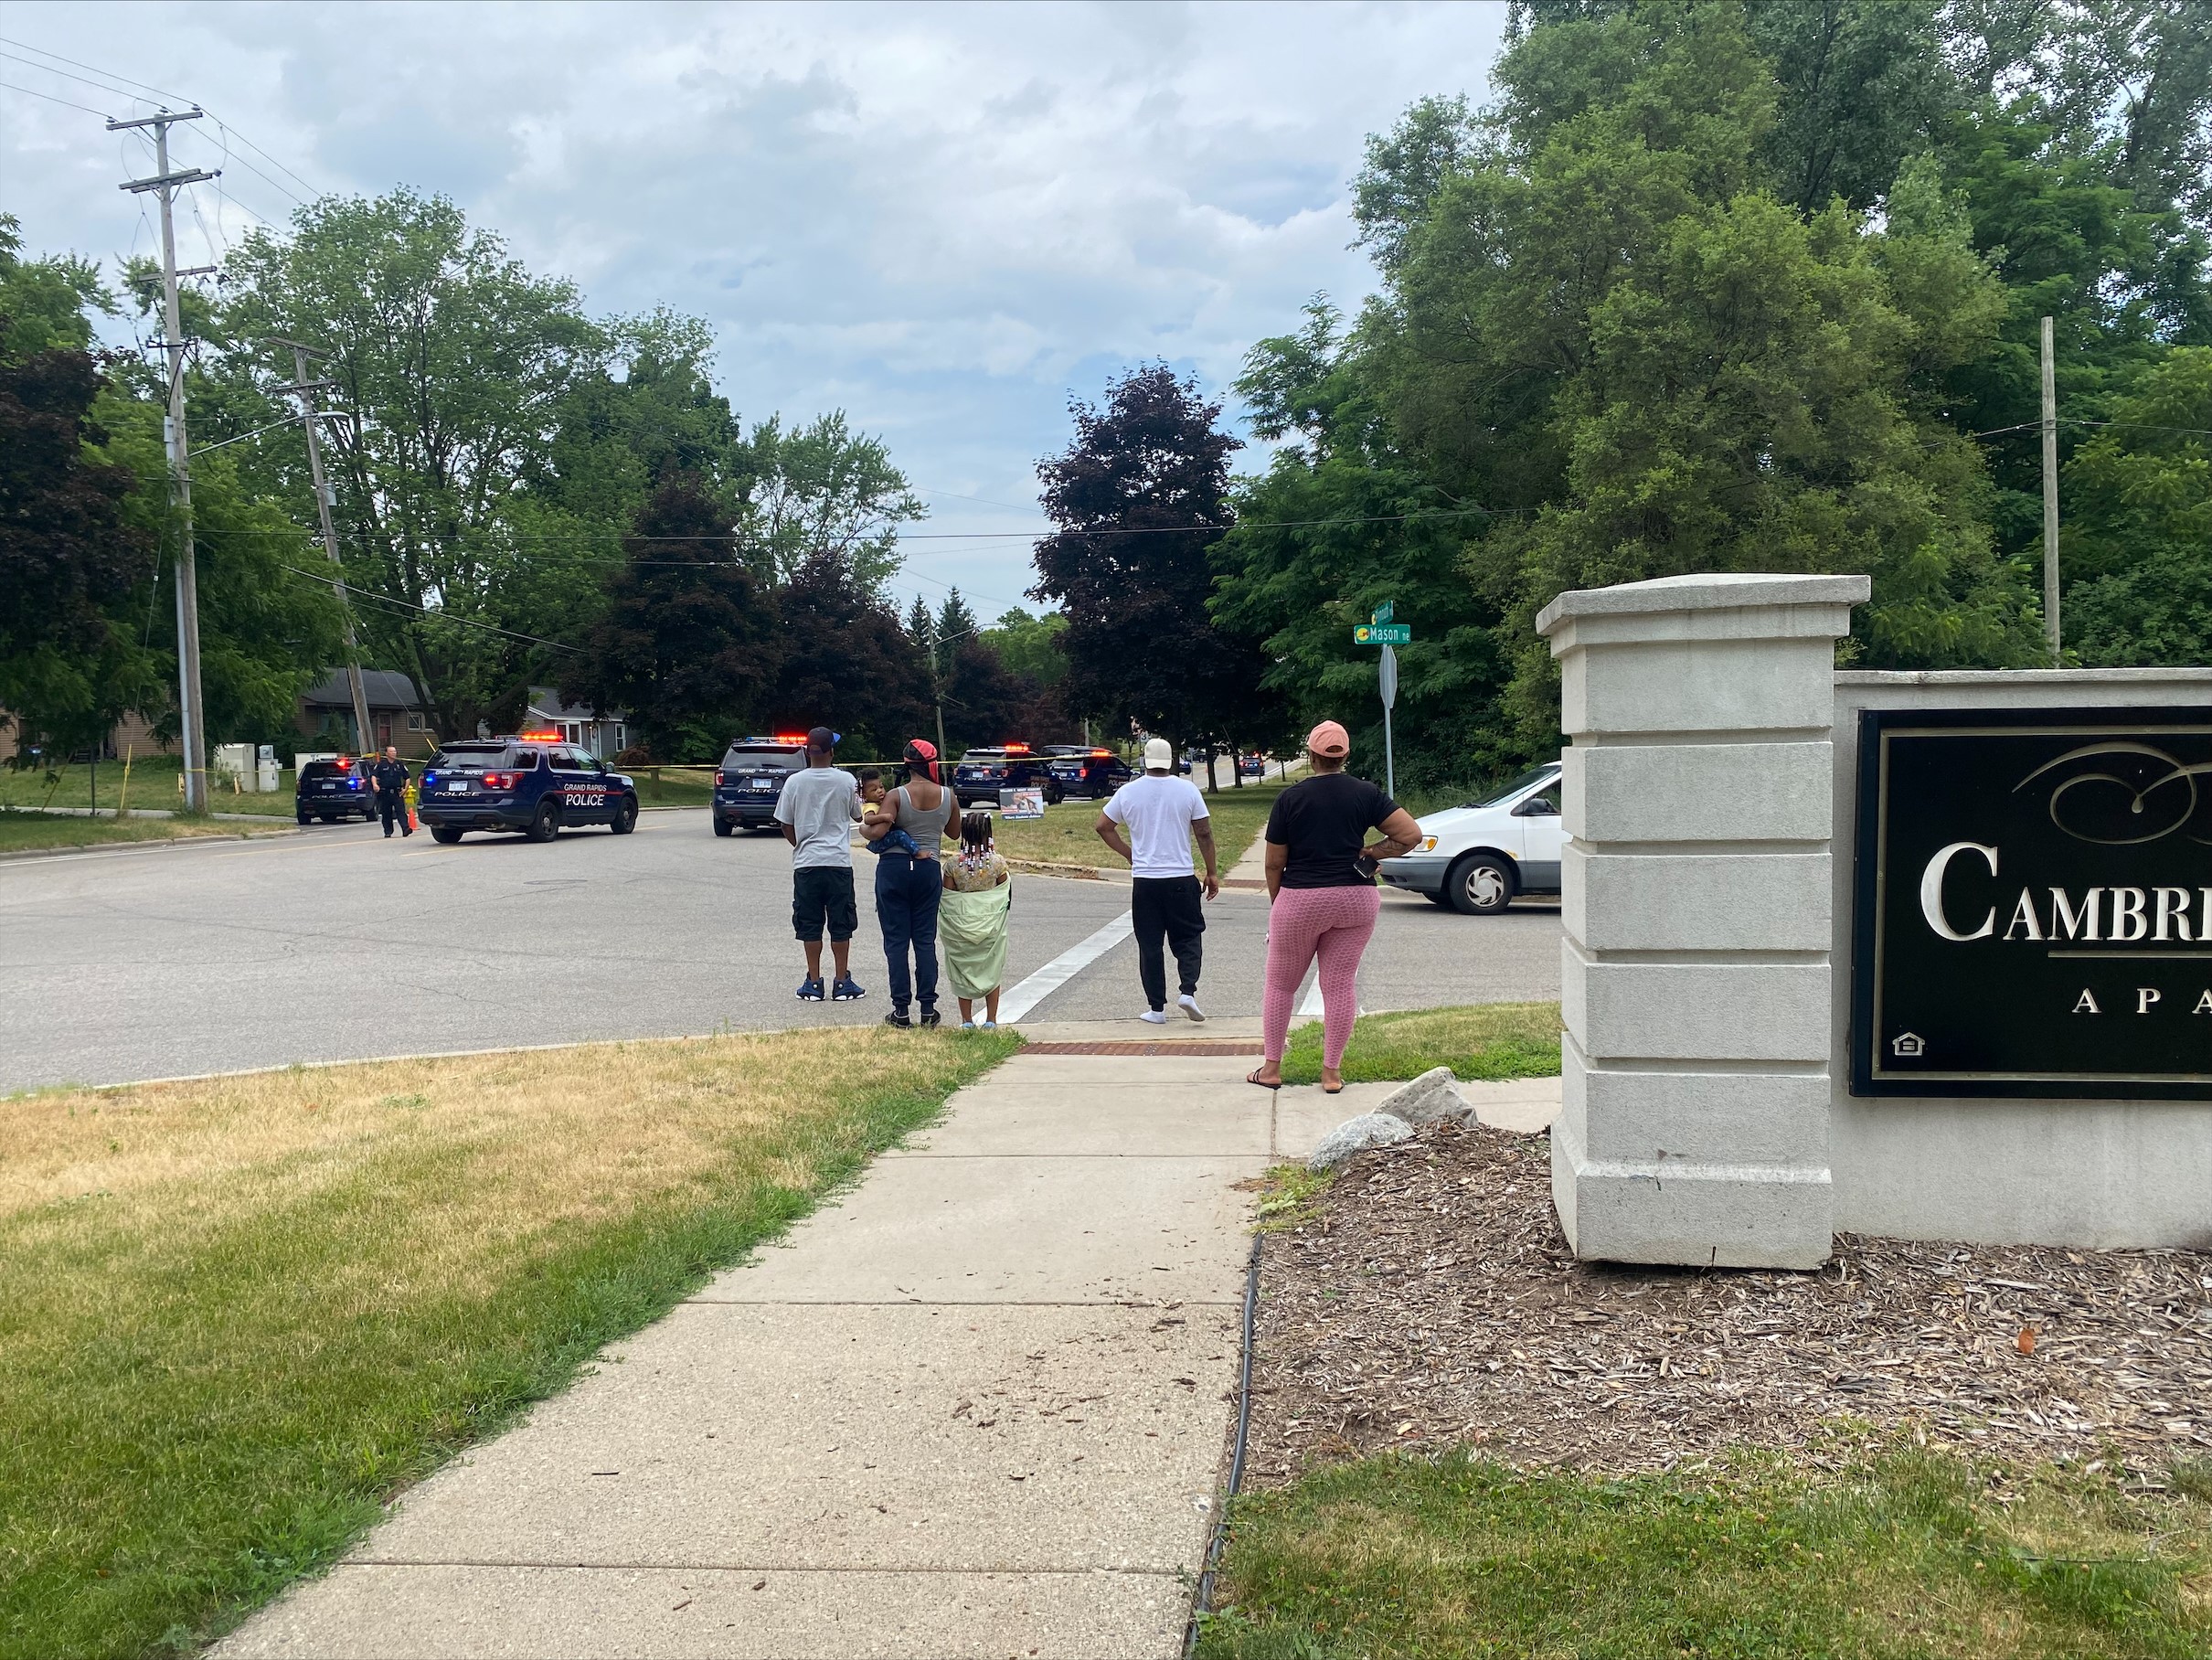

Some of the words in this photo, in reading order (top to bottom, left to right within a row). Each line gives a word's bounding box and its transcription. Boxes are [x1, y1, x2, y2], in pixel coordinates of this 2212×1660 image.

[1370, 627, 1398, 641] Mason
[564, 782, 586, 792] GRAND
[586, 783, 608, 793] RAPIDS
[566, 793, 605, 806] POLICE
[1920, 841, 2212, 942] CAMBRI
